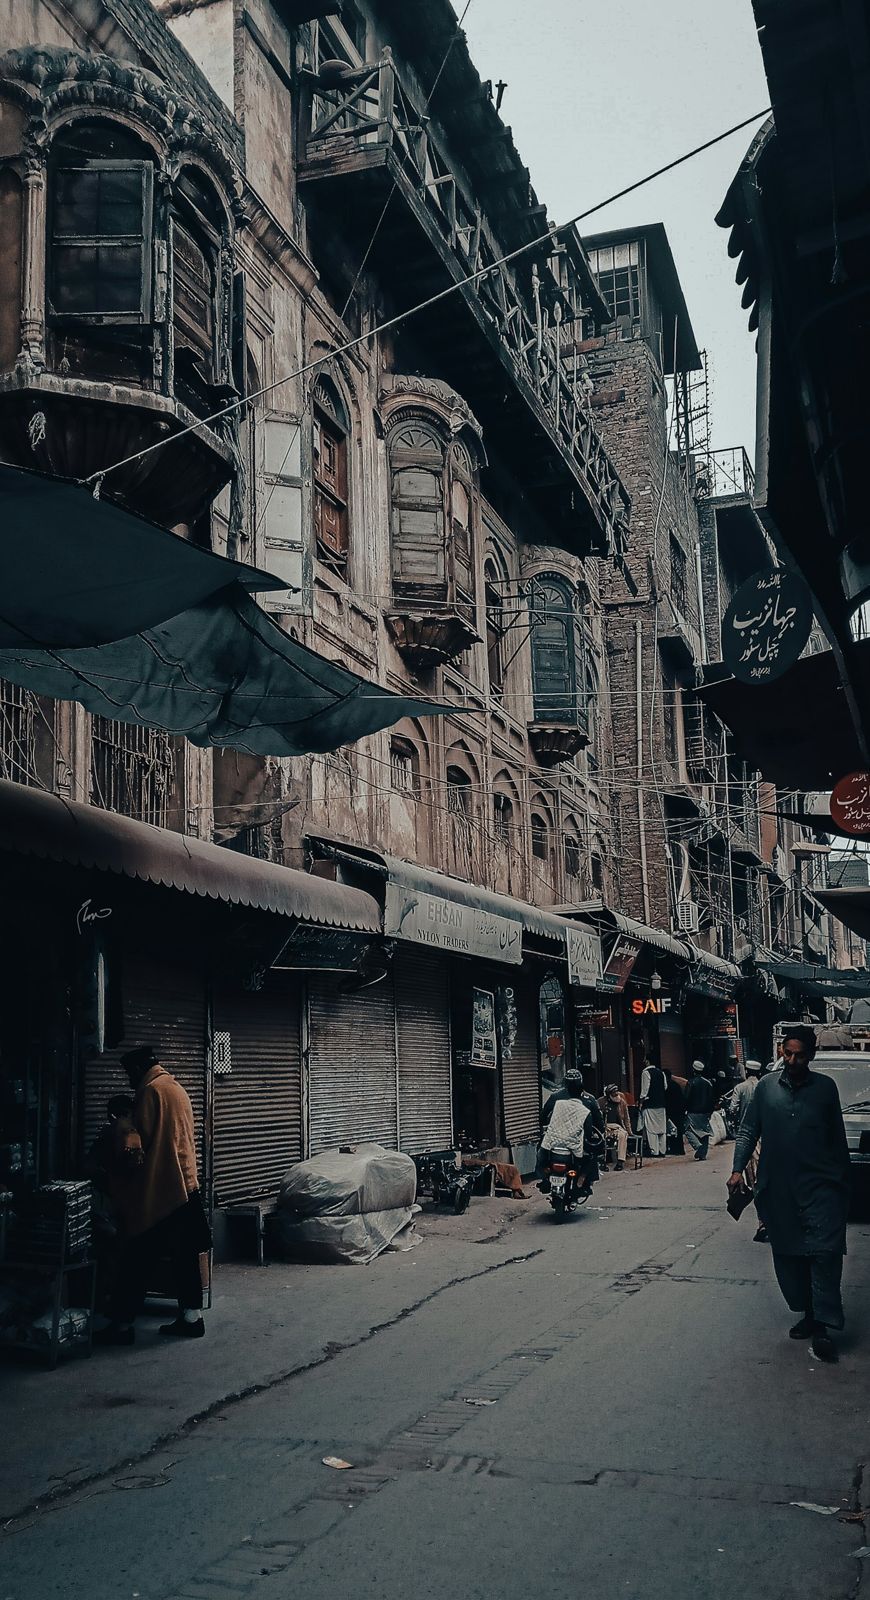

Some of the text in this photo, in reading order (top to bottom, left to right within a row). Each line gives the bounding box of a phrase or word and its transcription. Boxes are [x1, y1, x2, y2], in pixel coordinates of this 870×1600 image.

[733, 594, 797, 639] جہانزیب
[427, 901, 464, 928] EHSAN
[417, 928, 469, 951] NYLON TRADERS
[499, 923, 521, 950] احسان
[632, 998, 672, 1014] SAIF
